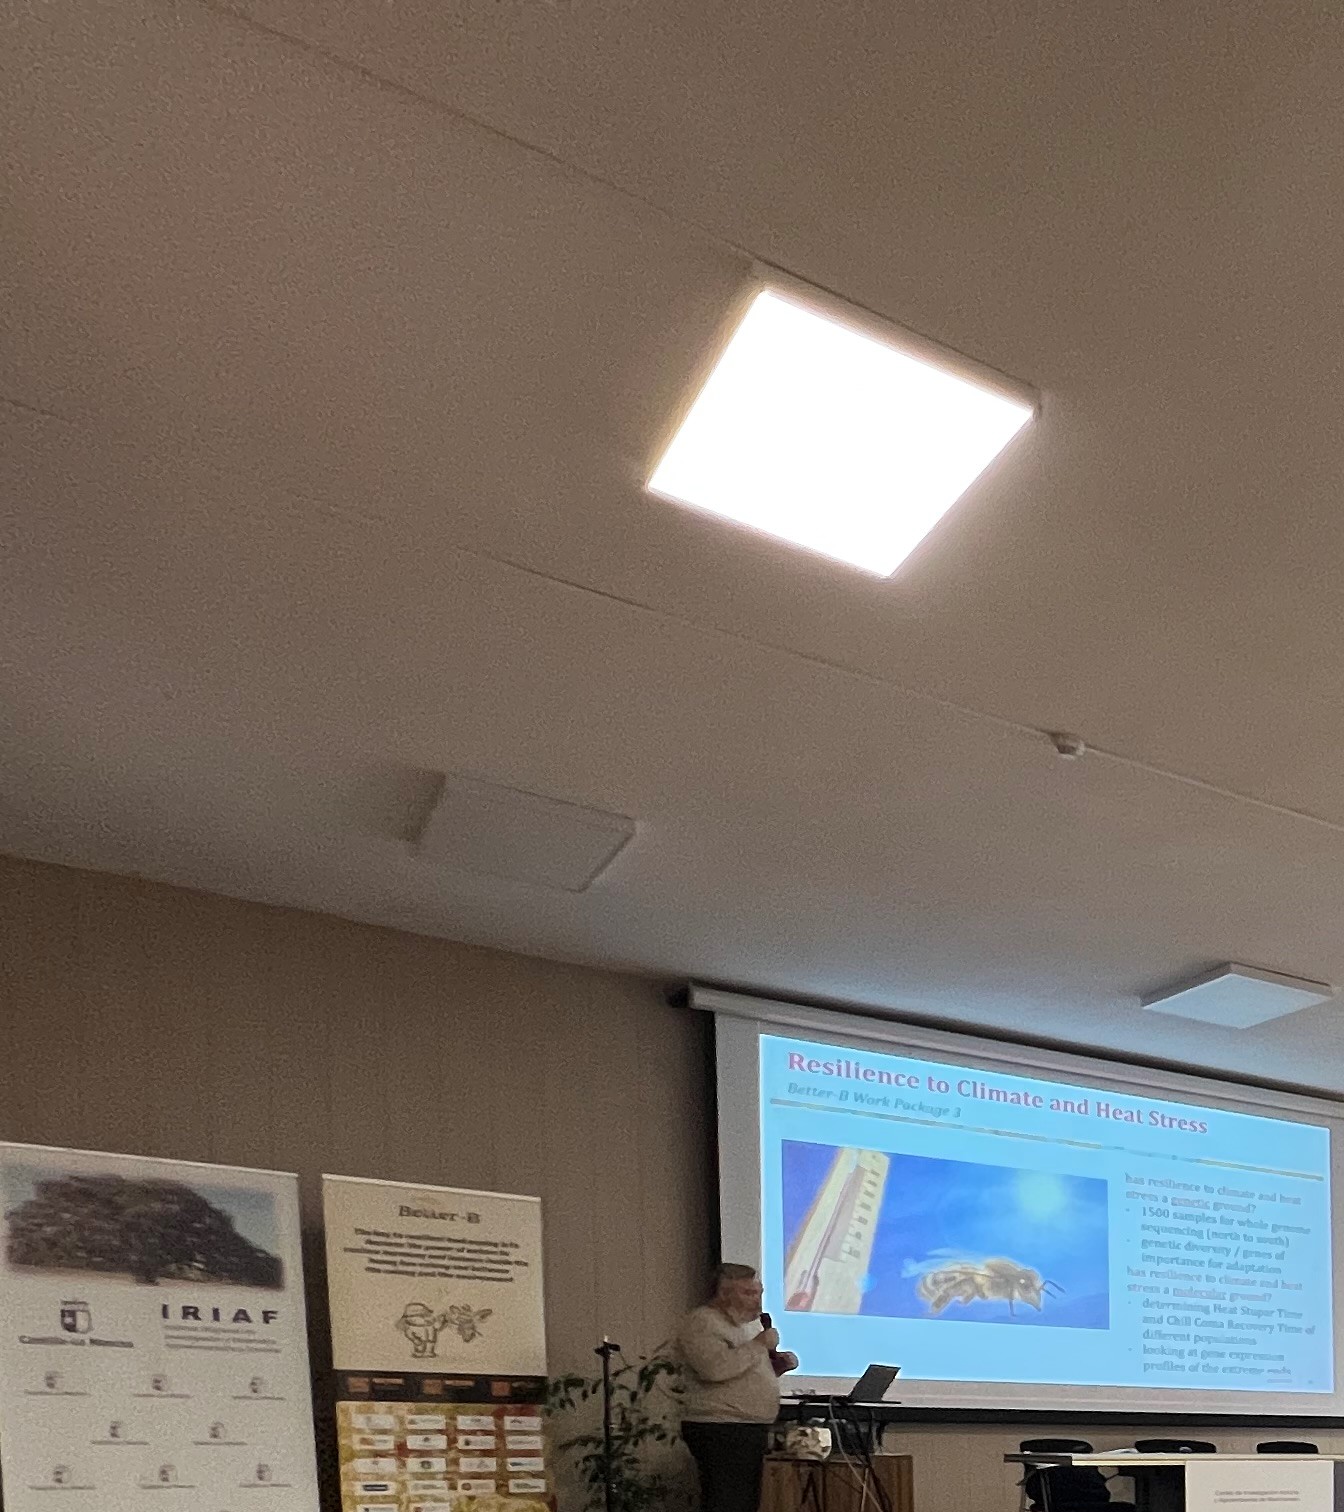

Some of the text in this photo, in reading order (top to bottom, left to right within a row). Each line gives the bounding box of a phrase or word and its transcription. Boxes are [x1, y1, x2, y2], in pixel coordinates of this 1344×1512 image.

[787, 1052, 1208, 1134] Resilience to Climate and Heat Stress
[787, 1082, 962, 1118] Better-B Work Package 3
[1125, 1173, 1145, 1185] has
[1148, 1177, 1200, 1193] resilience
[1204, 1184, 1214, 1194] to
[1142, 1206, 1170, 1219] 1500
[1173, 1211, 1217, 1224] samples
[1220, 1214, 1234, 1226] for
[1141, 1238, 1182, 1250] genetic
